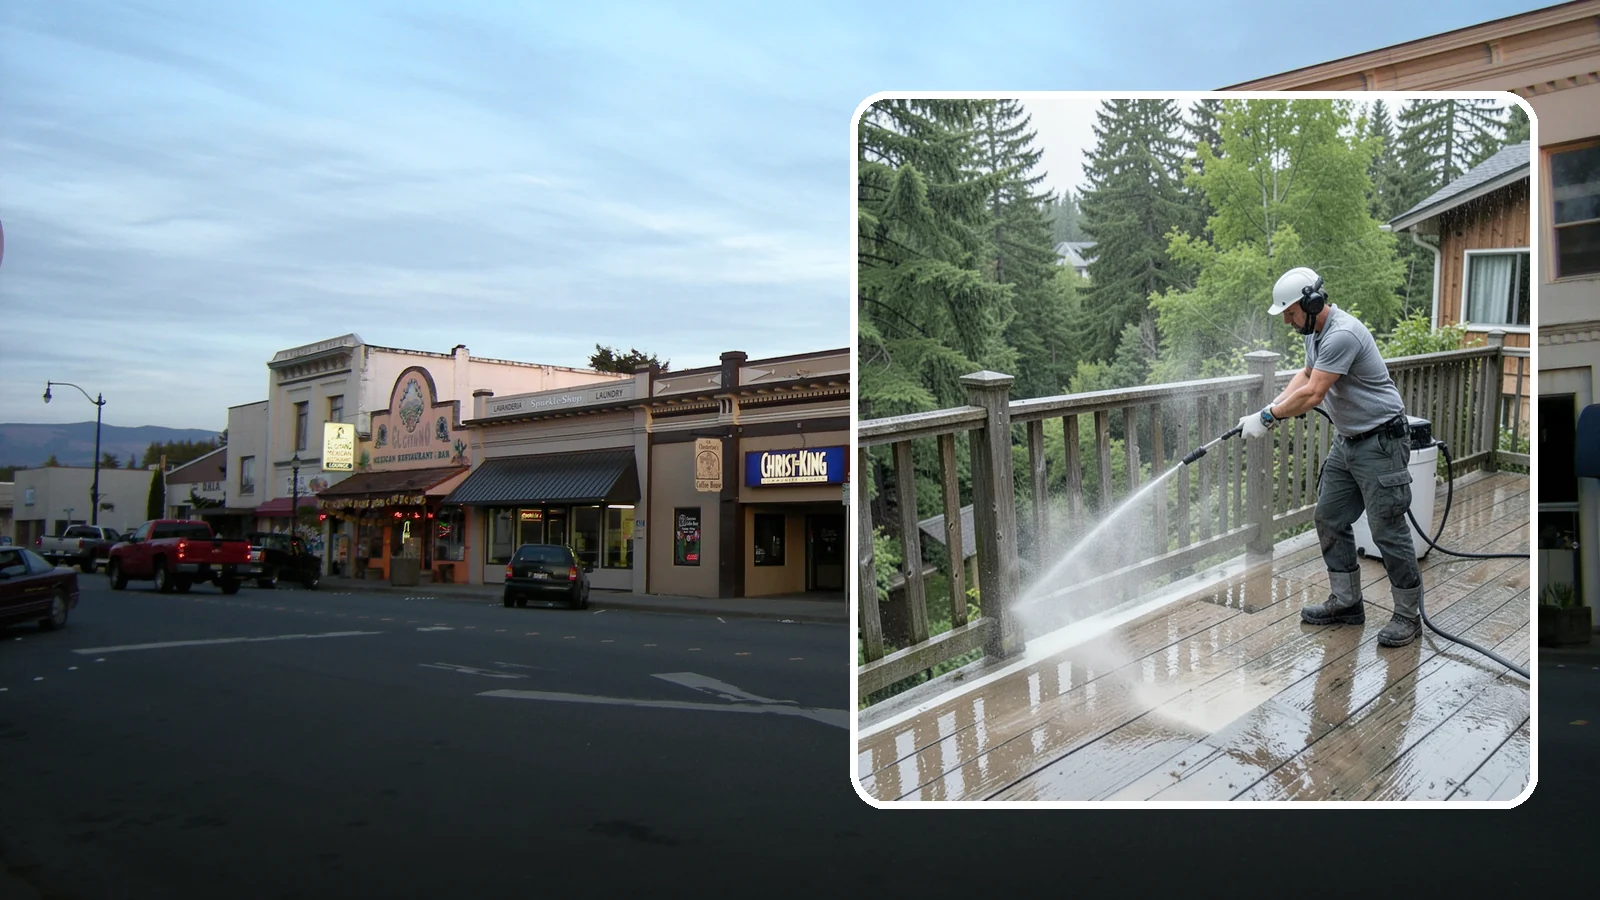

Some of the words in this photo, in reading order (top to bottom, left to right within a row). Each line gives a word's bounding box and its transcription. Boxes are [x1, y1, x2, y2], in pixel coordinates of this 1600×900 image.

[595, 389, 623, 400] LAUNDRY
[493, 402, 522, 413] LAVANDERIA
[531, 395, 560, 408] Sparkle
[373, 455, 396, 464] MEXICAN
[397, 451, 433, 462] RESTAURANT
[438, 450, 450, 459] BAR
[760, 452, 797, 478] CHRIST
[799, 450, 827, 476] KING
[696, 480, 709, 489] Coffee
